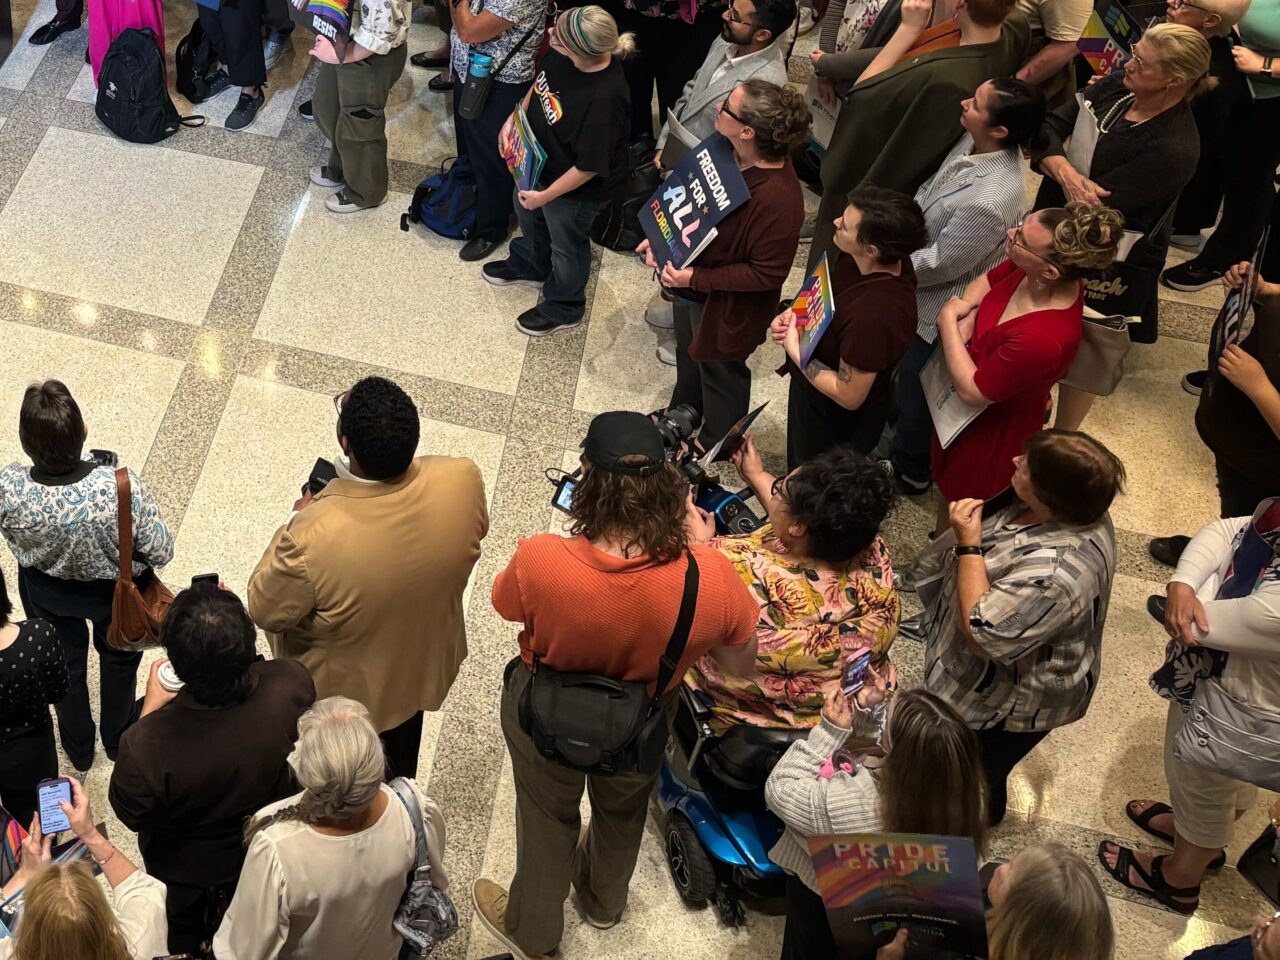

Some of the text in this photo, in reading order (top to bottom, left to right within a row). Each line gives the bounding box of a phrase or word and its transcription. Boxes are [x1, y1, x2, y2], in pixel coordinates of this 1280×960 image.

[689, 178, 708, 209] FOR
[696, 148, 732, 211] FREEDOM
[650, 199, 684, 263] FLORIDIANS
[663, 184, 702, 249] ALL
